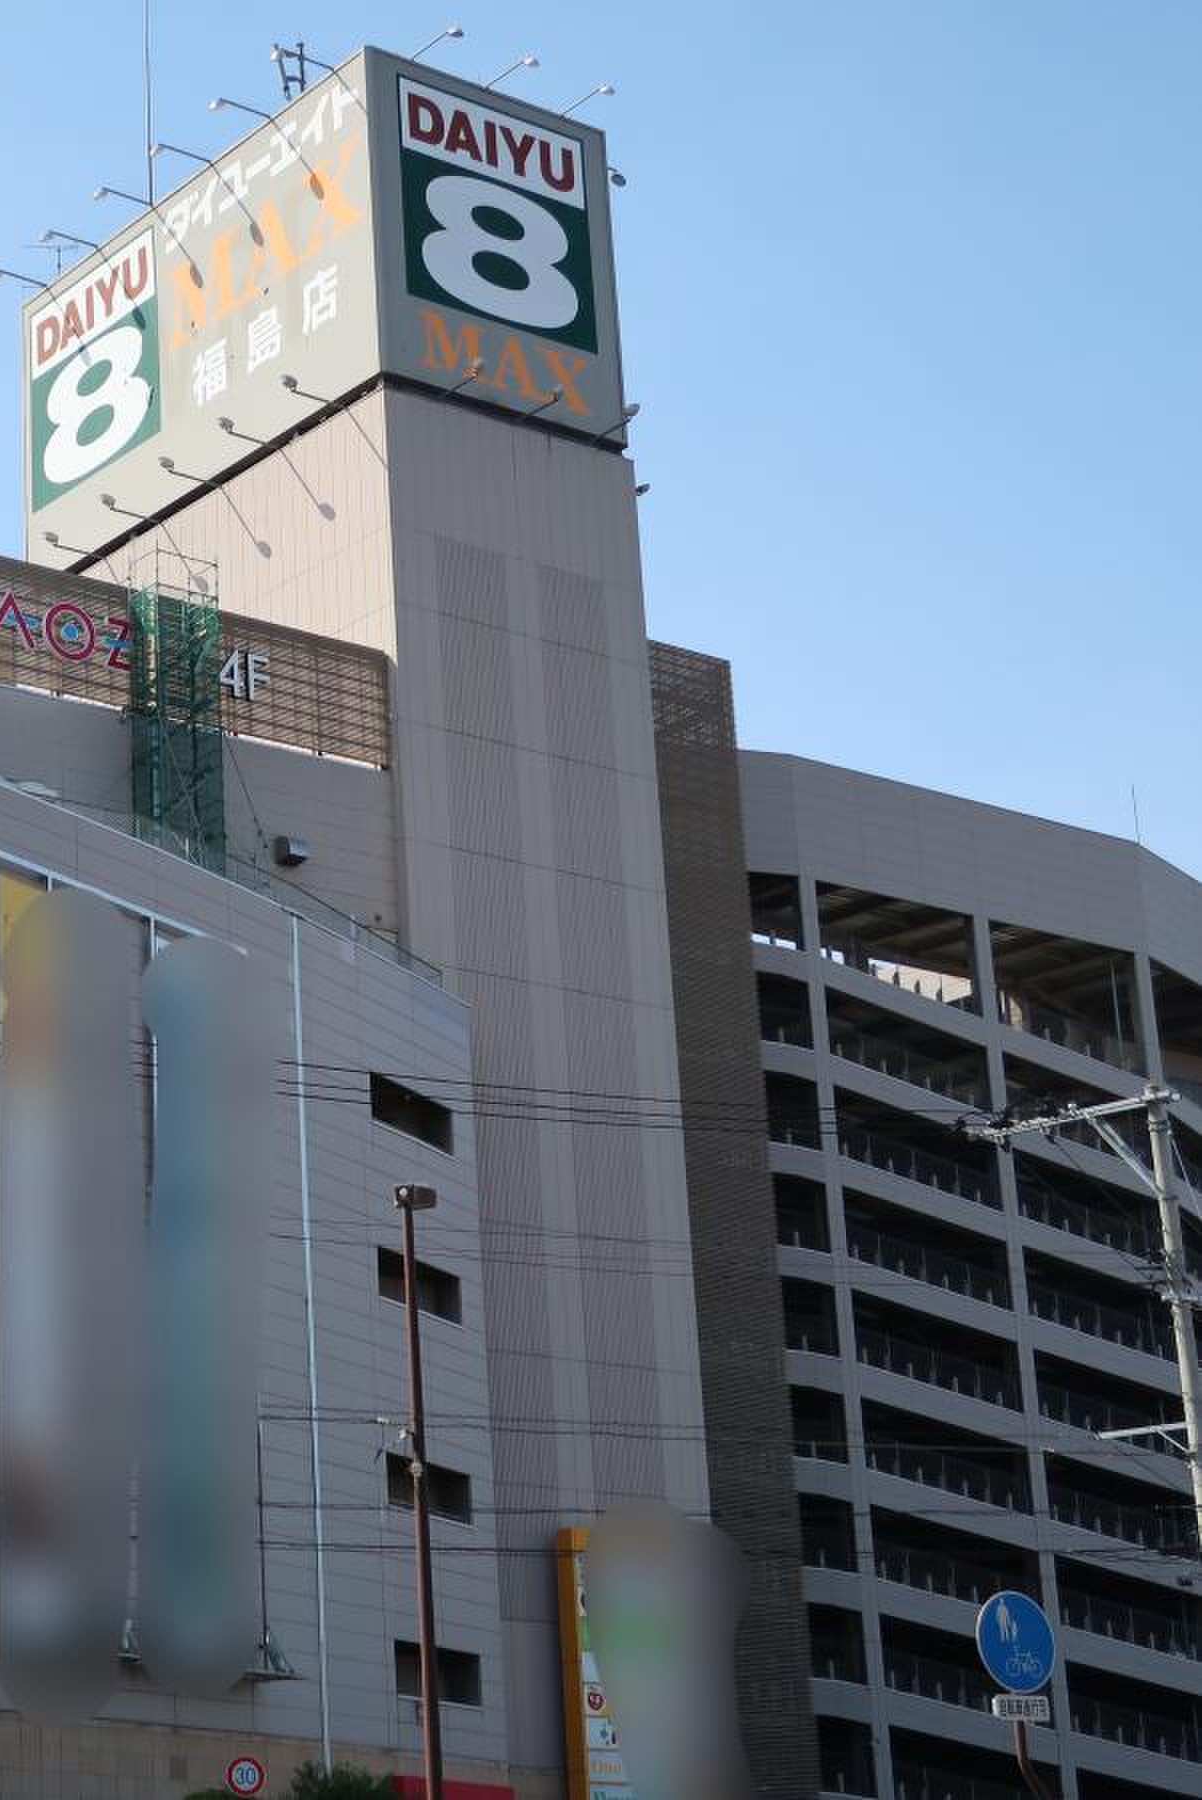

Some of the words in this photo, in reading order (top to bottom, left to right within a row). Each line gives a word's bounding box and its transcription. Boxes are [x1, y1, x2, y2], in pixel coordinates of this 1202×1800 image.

[164, 84, 360, 252] ダイユーエイト
[407, 92, 576, 193] DAIYU
[35, 246, 150, 365] DAIYU
[167, 129, 366, 352] MAX
[421, 174, 579, 329] 8
[42, 324, 151, 484] 8
[191, 263, 339, 407] 福島店
[417, 309, 591, 417] MAX
[235, 1766, 257, 1785] 30
